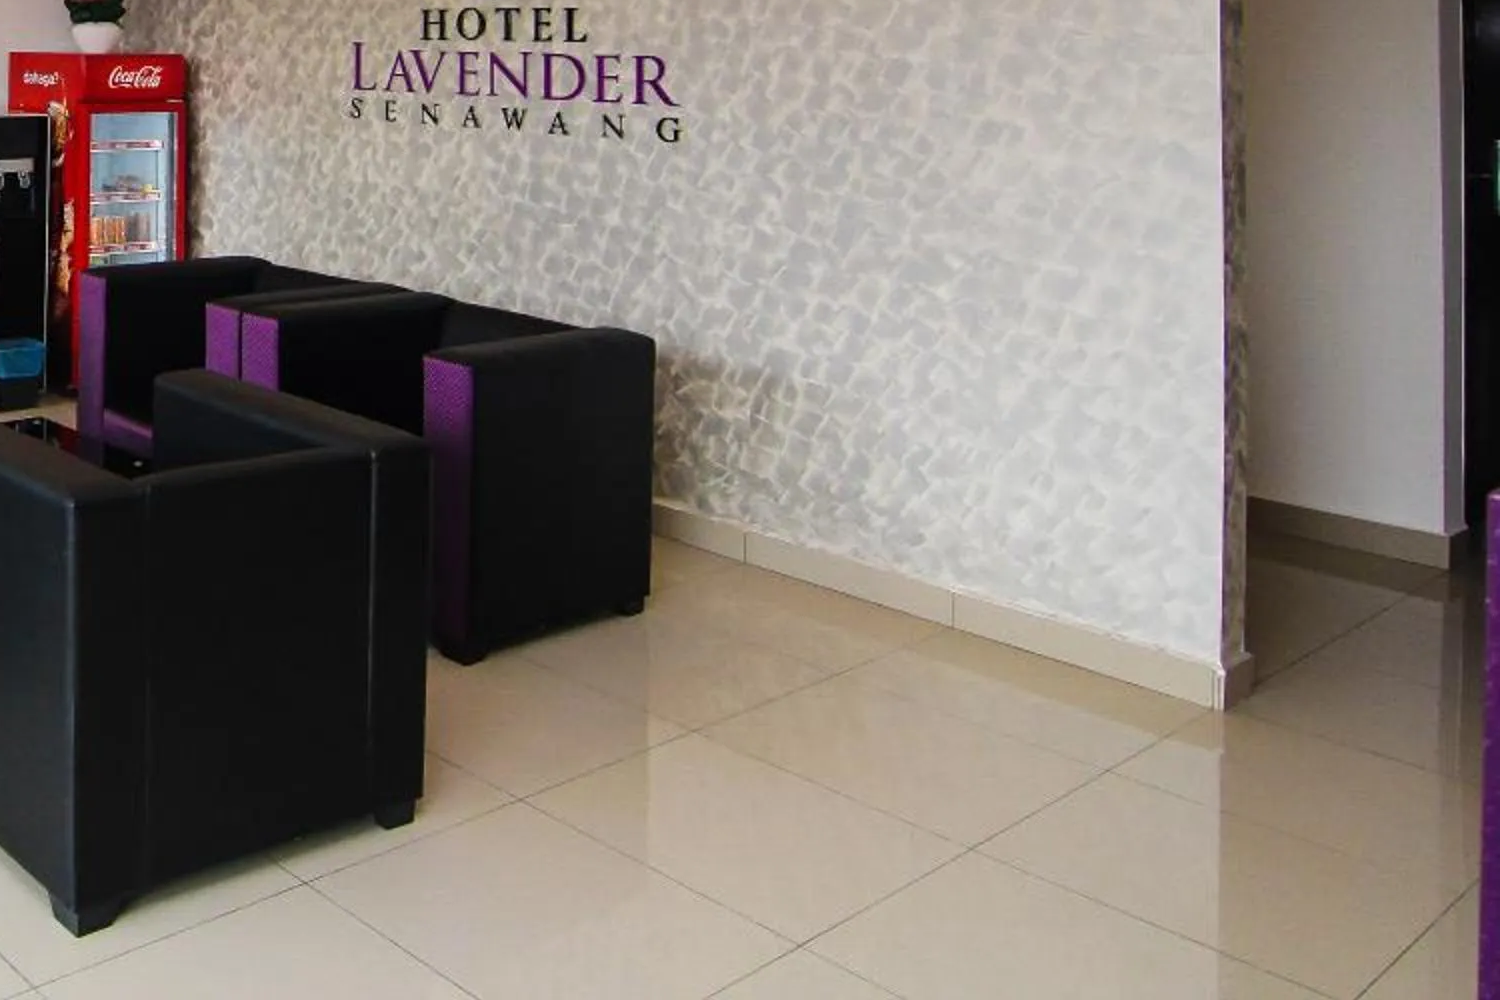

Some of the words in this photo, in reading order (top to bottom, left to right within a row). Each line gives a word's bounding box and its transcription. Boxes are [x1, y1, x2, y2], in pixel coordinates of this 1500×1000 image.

[420, 7, 588, 43] HOTEL
[108, 65, 163, 89] Coca-Cola
[352, 42, 680, 107] LAVENDER
[349, 98, 683, 143] SENAWANG
